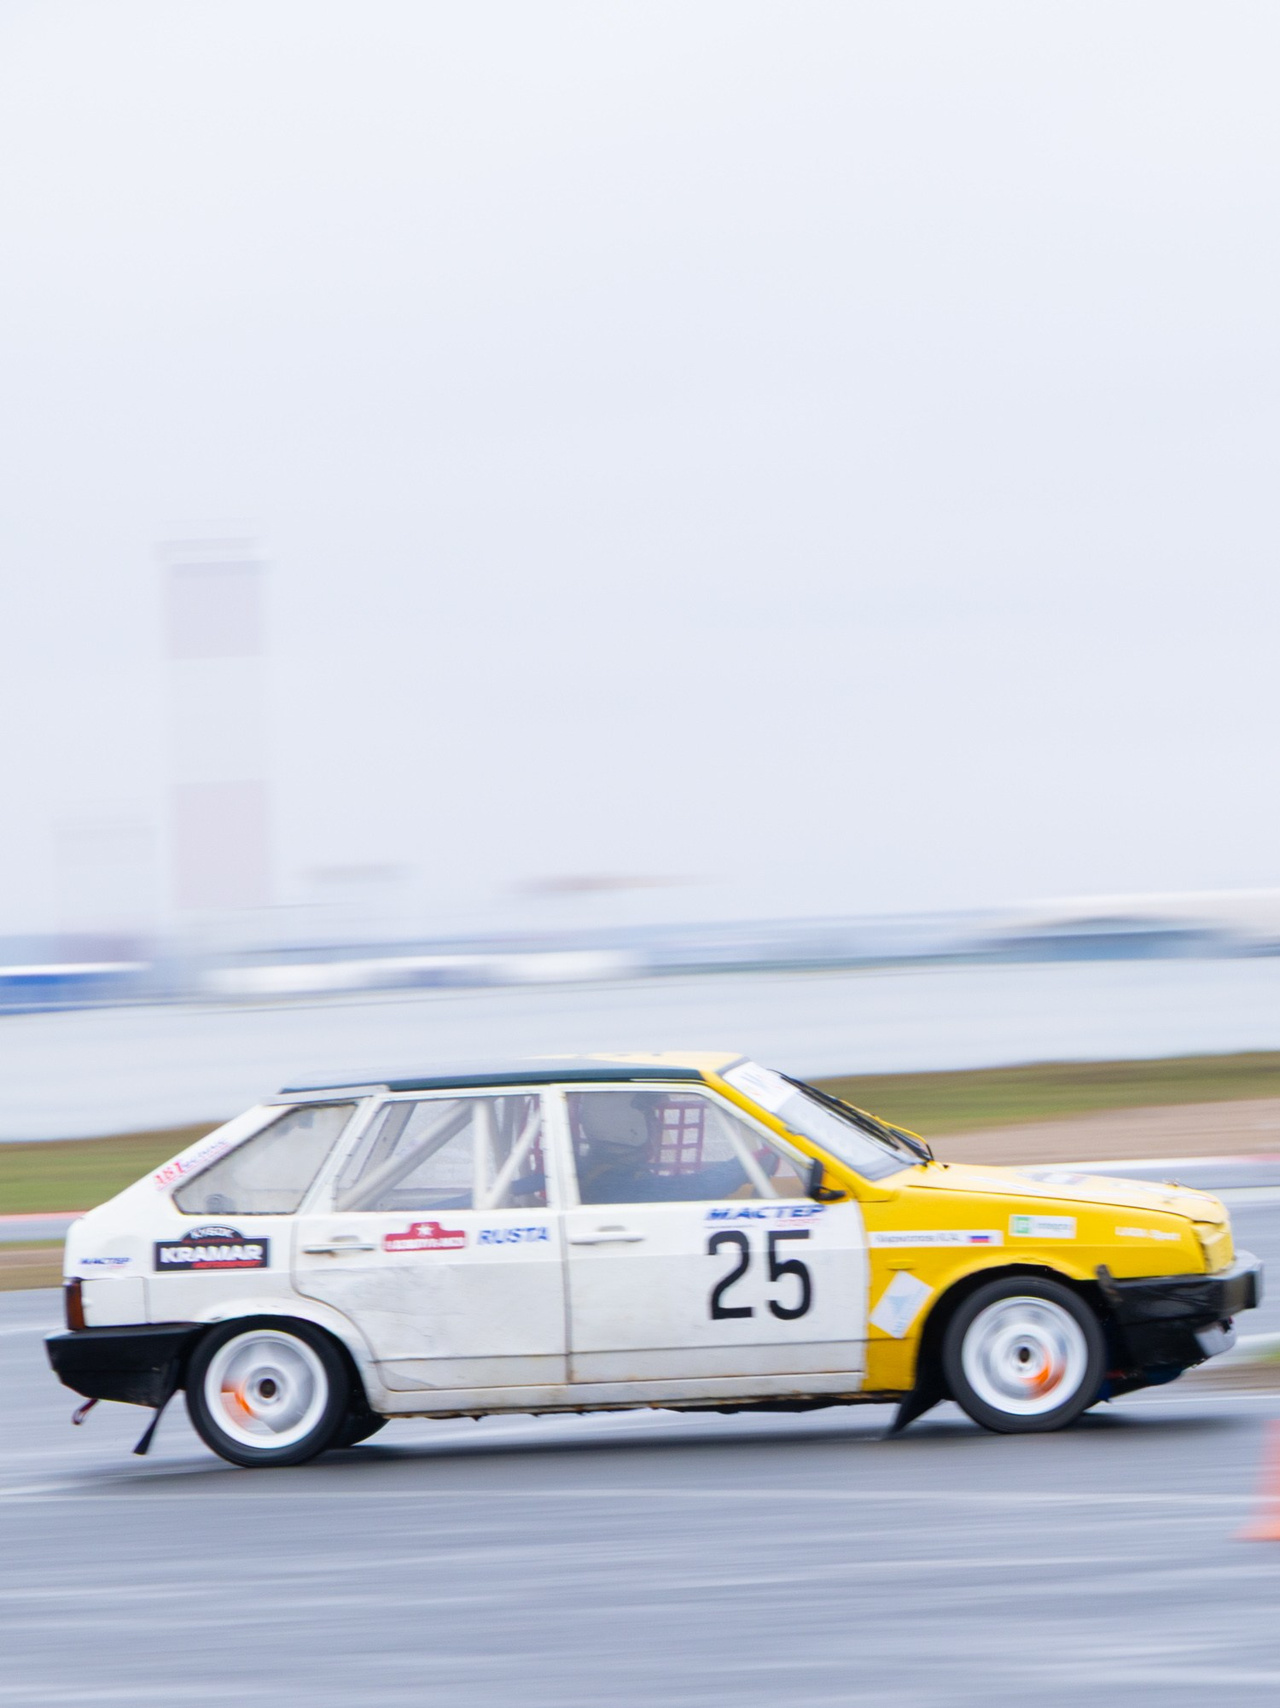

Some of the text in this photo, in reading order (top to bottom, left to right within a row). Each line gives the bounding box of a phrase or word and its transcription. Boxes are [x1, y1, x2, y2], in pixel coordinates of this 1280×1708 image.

[478, 1227, 550, 1245] RUSTA
[160, 1244, 264, 1264] KRAMAR
[706, 1229, 811, 1321] 25
